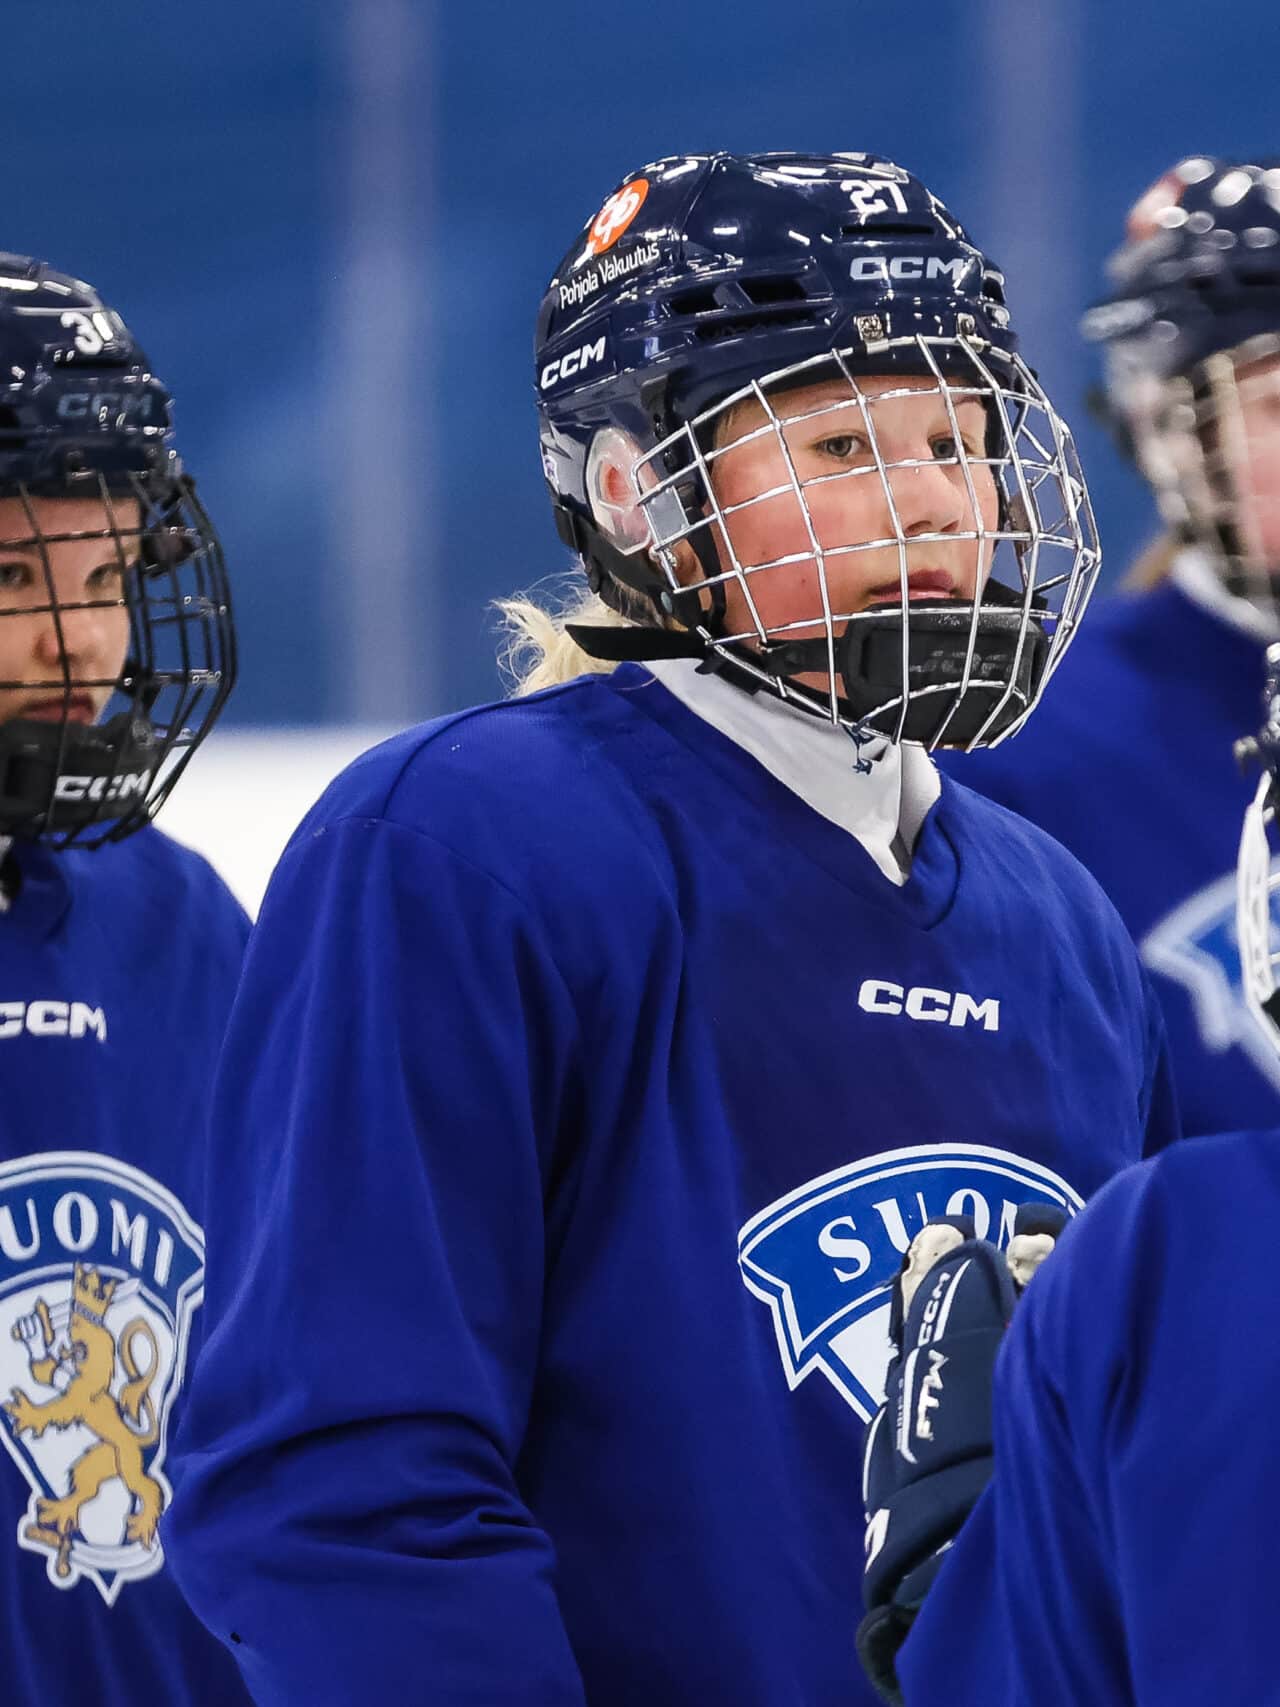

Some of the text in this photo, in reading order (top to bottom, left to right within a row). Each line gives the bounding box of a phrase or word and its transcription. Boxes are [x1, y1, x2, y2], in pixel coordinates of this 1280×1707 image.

[840, 179, 908, 213] 27
[560, 242, 660, 310] Pohjola Vakuutus
[850, 257, 966, 280] CCM
[541, 336, 606, 390] CCM
[858, 979, 999, 1031] CCM
[0, 1191, 174, 1288] UOMI
[817, 1188, 1019, 1283] SUO
[917, 1271, 951, 1348] CCM
